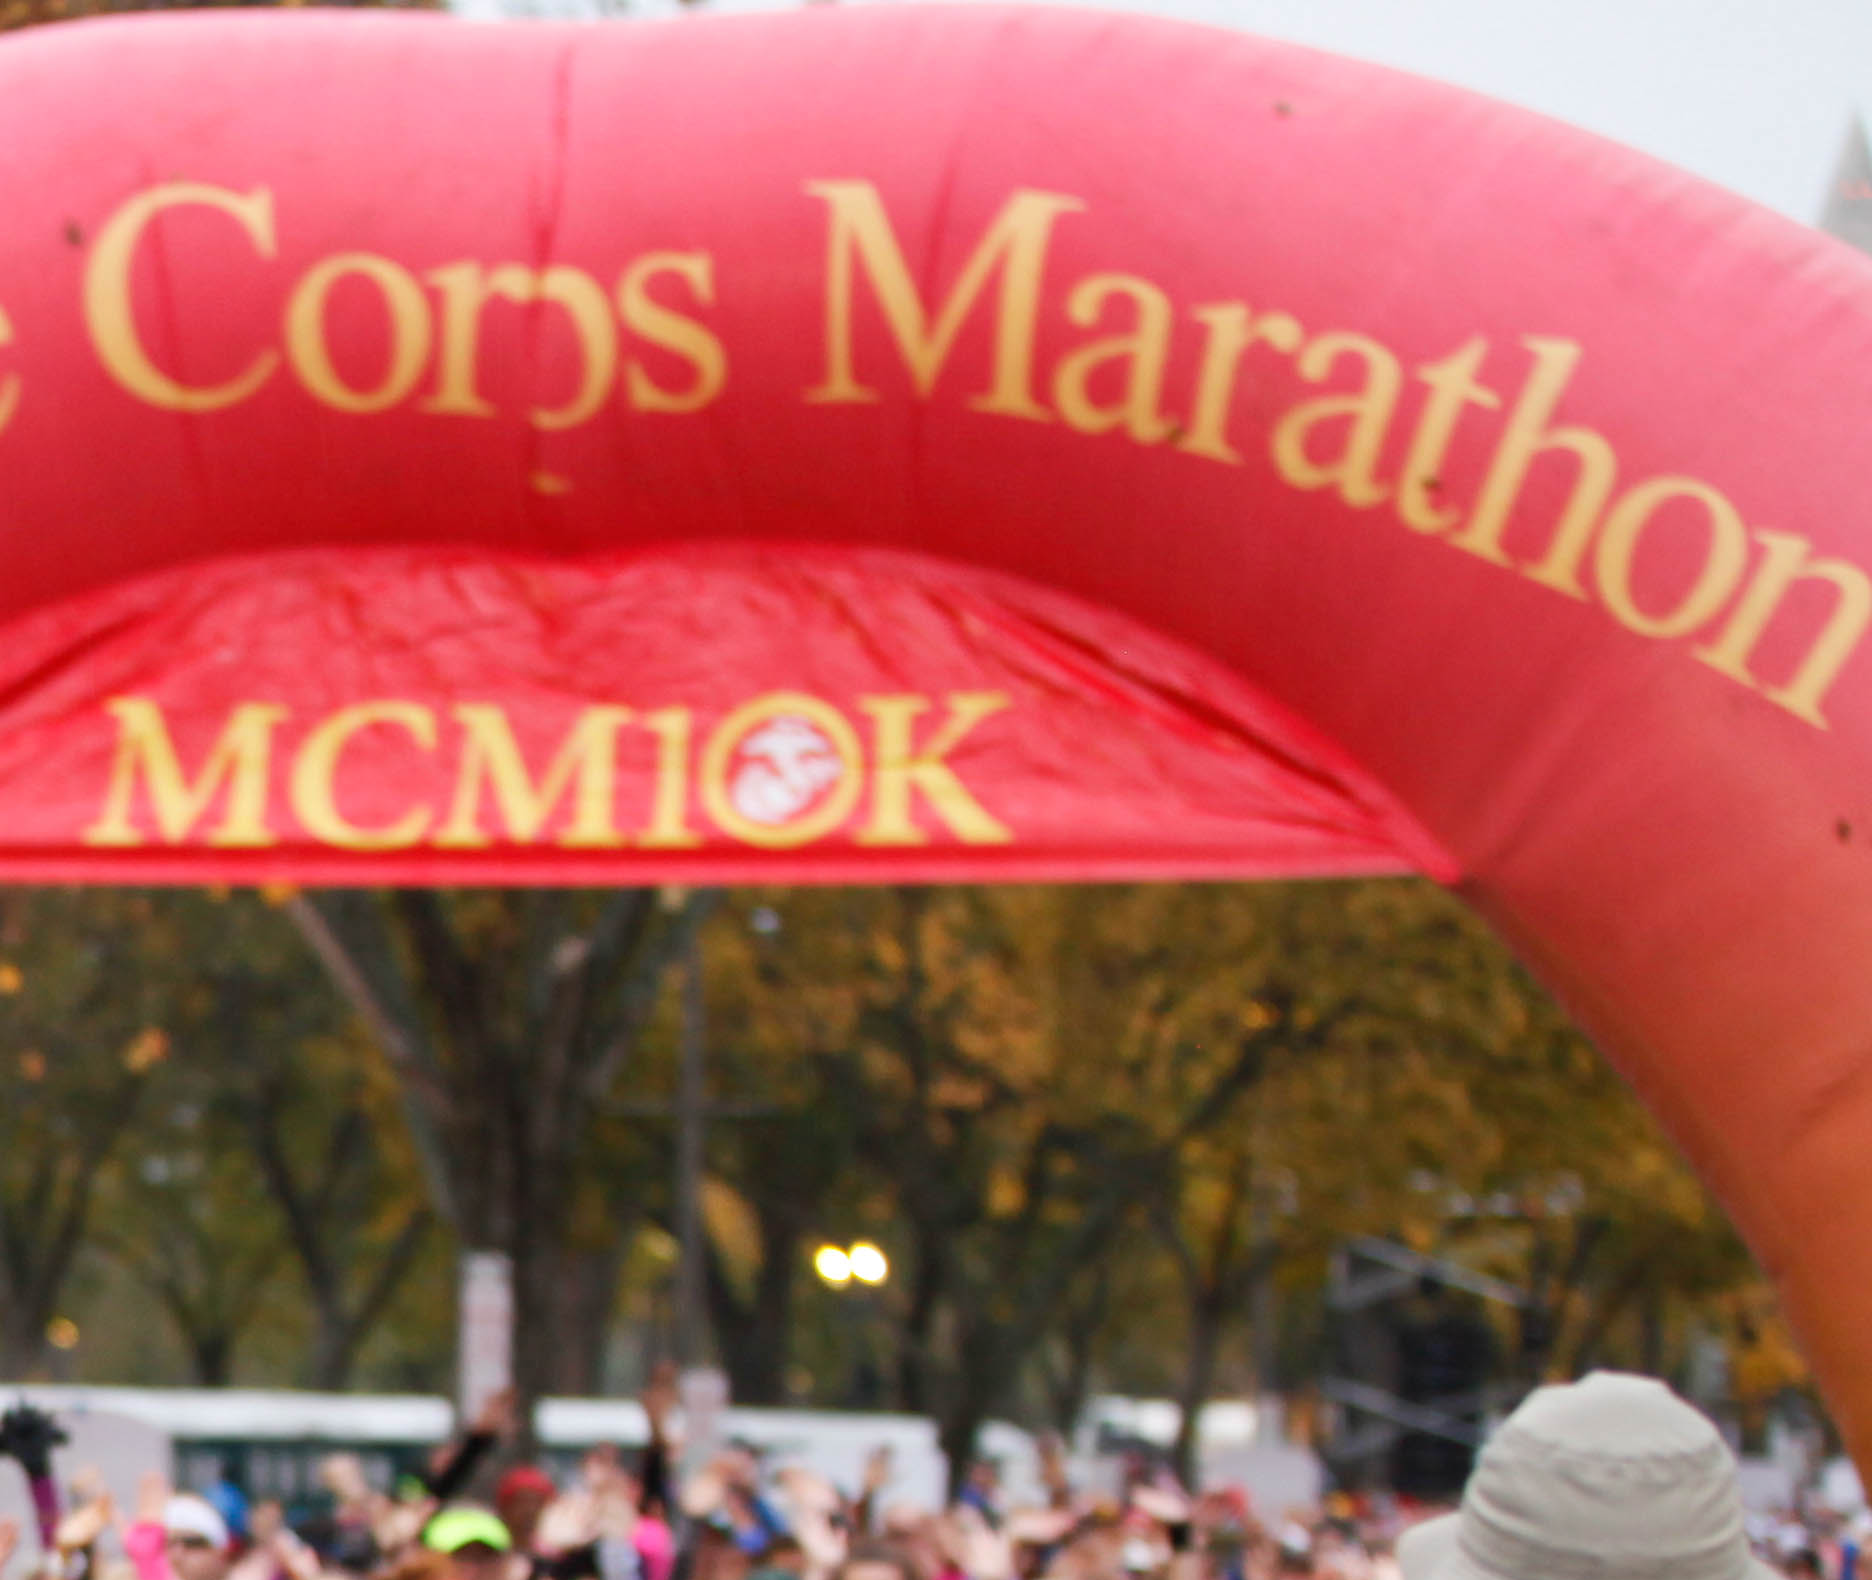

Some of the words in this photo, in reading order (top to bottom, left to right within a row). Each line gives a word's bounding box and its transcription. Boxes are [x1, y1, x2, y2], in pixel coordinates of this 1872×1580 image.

[83, 180, 727, 485] Corps
[802, 178, 1872, 731] Marathon
[90, 690, 1013, 851] MCM10K
